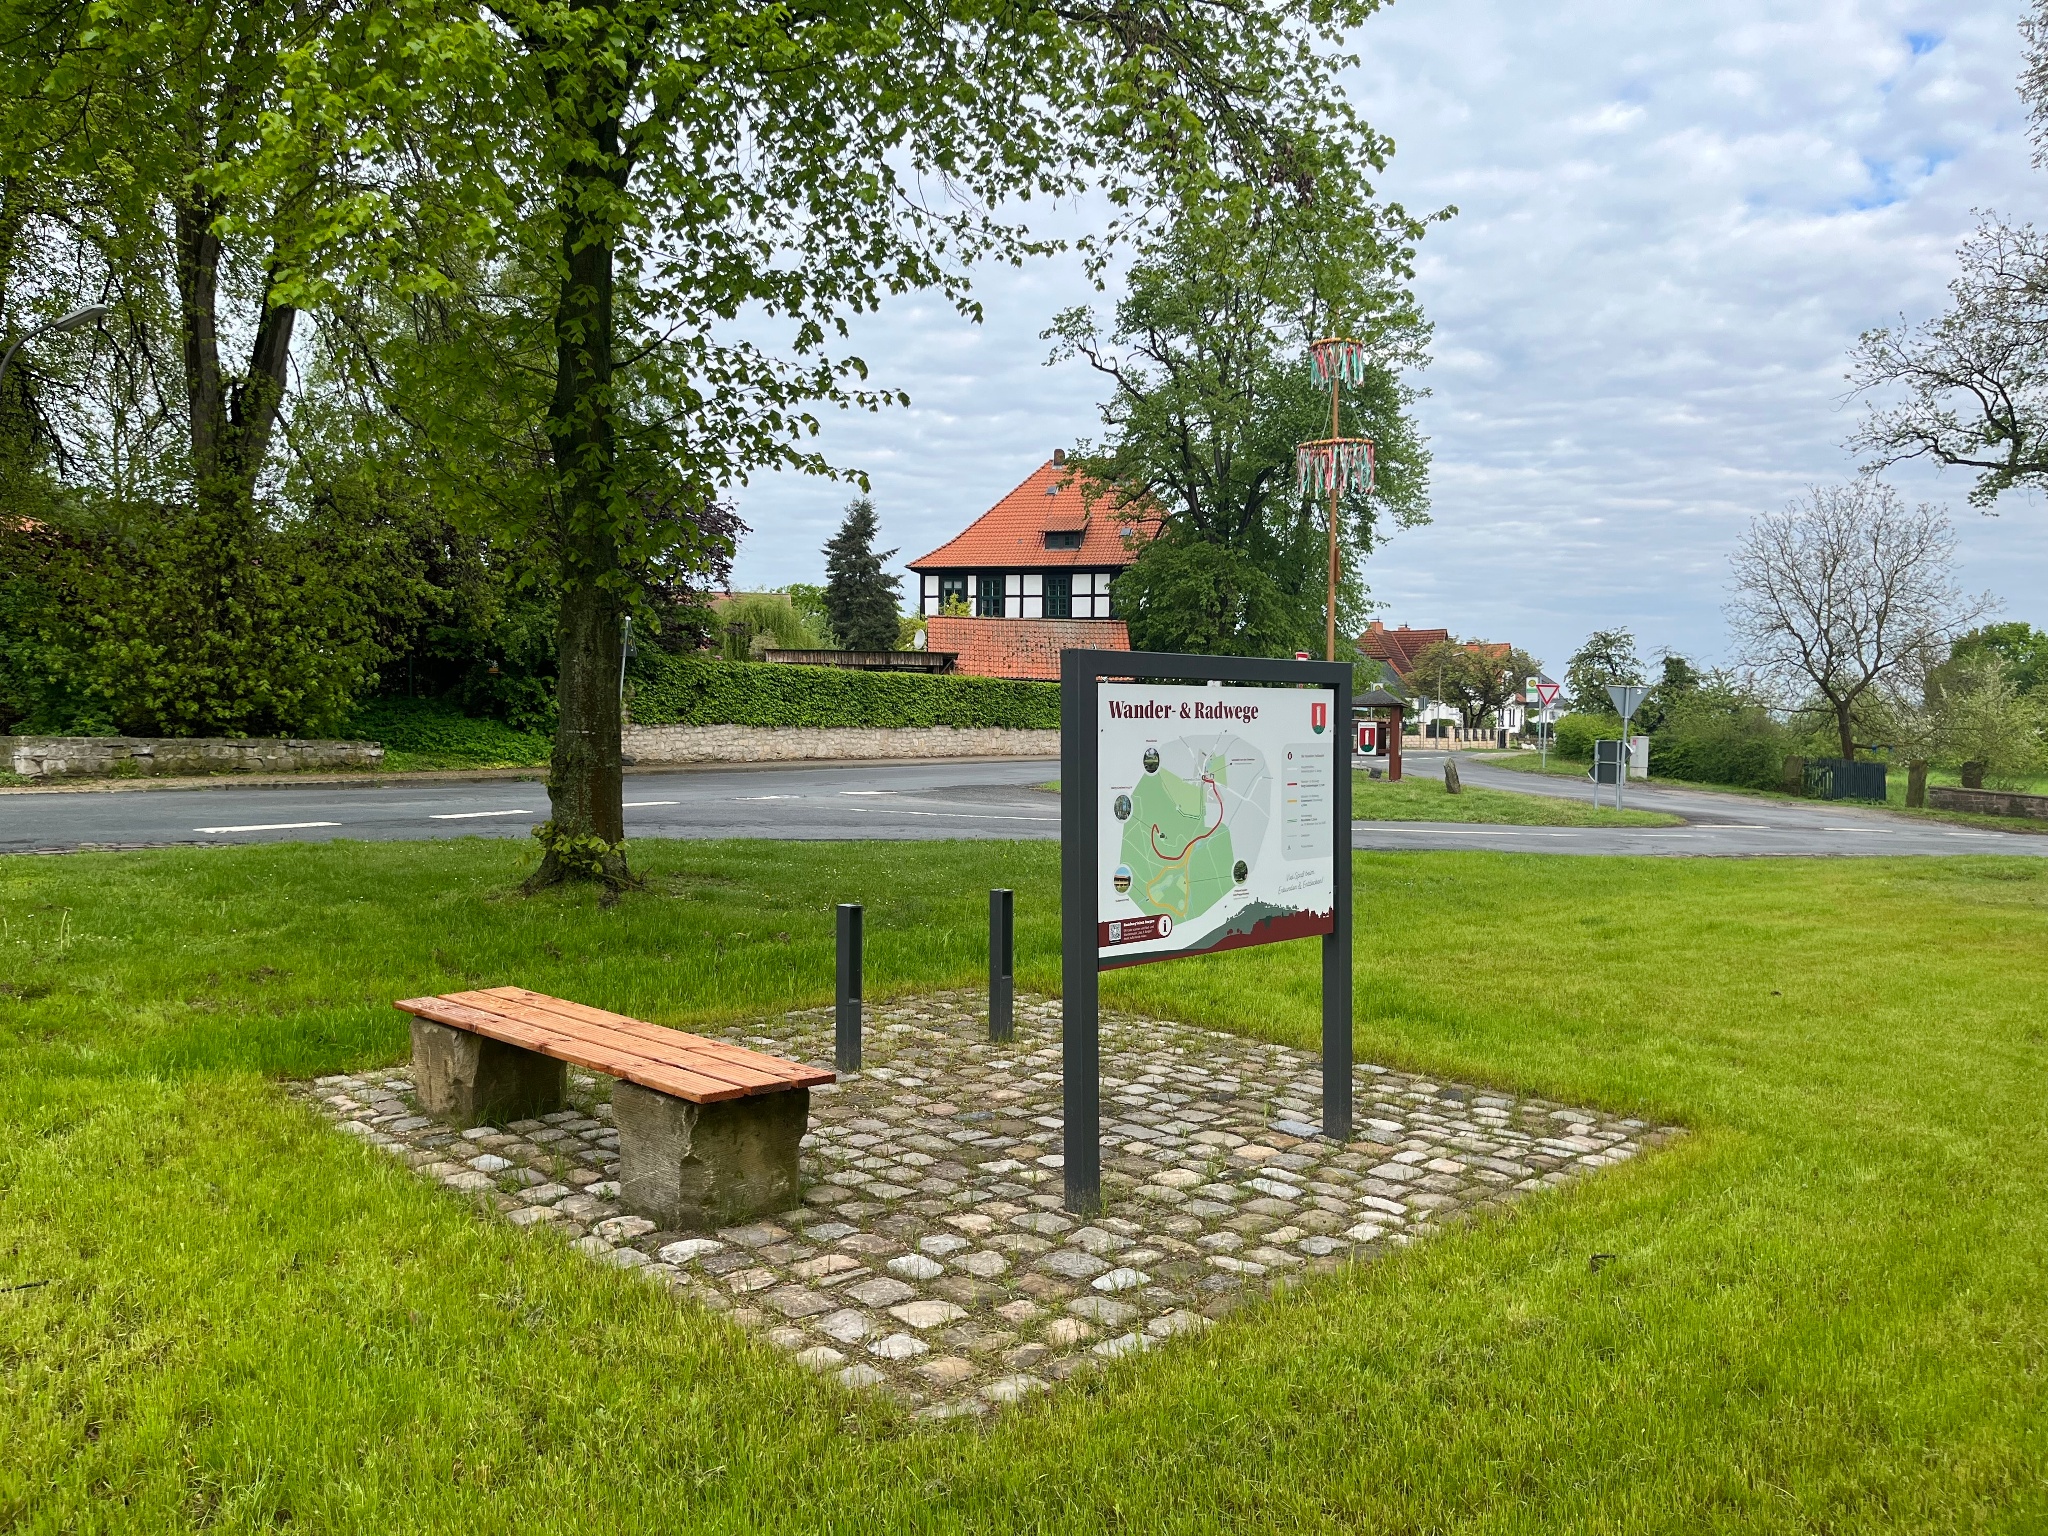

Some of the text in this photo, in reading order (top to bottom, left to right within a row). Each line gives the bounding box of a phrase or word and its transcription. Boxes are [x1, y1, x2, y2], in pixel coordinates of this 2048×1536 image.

[1108, 700, 1259, 724] Wander- & Radwege
